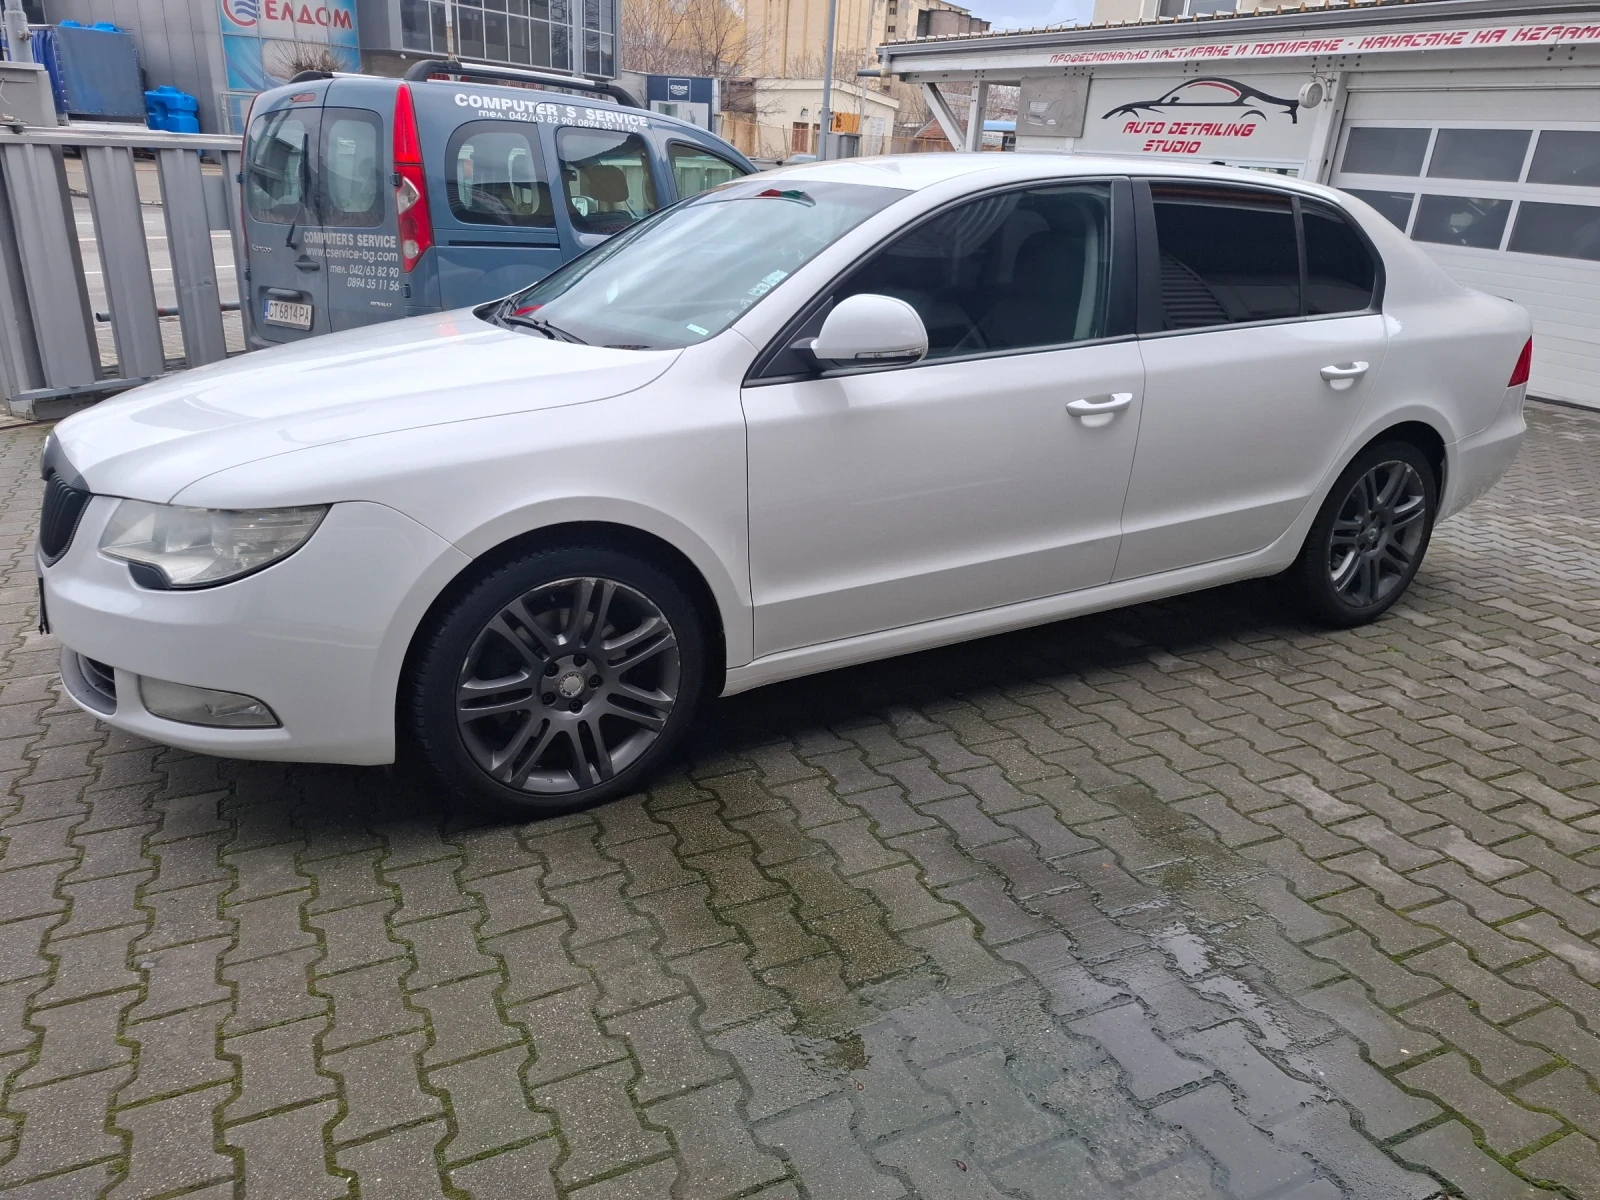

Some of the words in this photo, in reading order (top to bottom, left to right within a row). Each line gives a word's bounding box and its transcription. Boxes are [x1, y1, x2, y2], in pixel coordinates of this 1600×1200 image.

[264, 0, 353, 30] ЕЛДОМ
[1250, 38, 1345, 55] ПОЛИРАНЕ
[1357, 31, 1470, 50] НАНАСЯНЕ
[1470, 29, 1508, 44] НА
[508, 112, 544, 123] 042/63
[546, 115, 559, 125] 82
[578, 118, 600, 129] 0894
[602, 121, 613, 130] 35
[627, 124, 638, 133] 56
[585, 108, 649, 127] SERVICE
[1122, 121, 1166, 134] AUTO
[1167, 122, 1257, 137] DETAILING
[1142, 140, 1202, 153] STUDIO
[356, 234, 397, 248] SERVICE
[305, 247, 399, 263] www.cservice-bg.com
[349, 265, 376, 277] 042/63
[376, 267, 387, 277] 82
[388, 267, 400, 278] 90
[346, 277, 365, 289] 0894
[366, 278, 377, 289] 35
[378, 279, 388, 290] 11
[388, 280, 400, 291] 56
